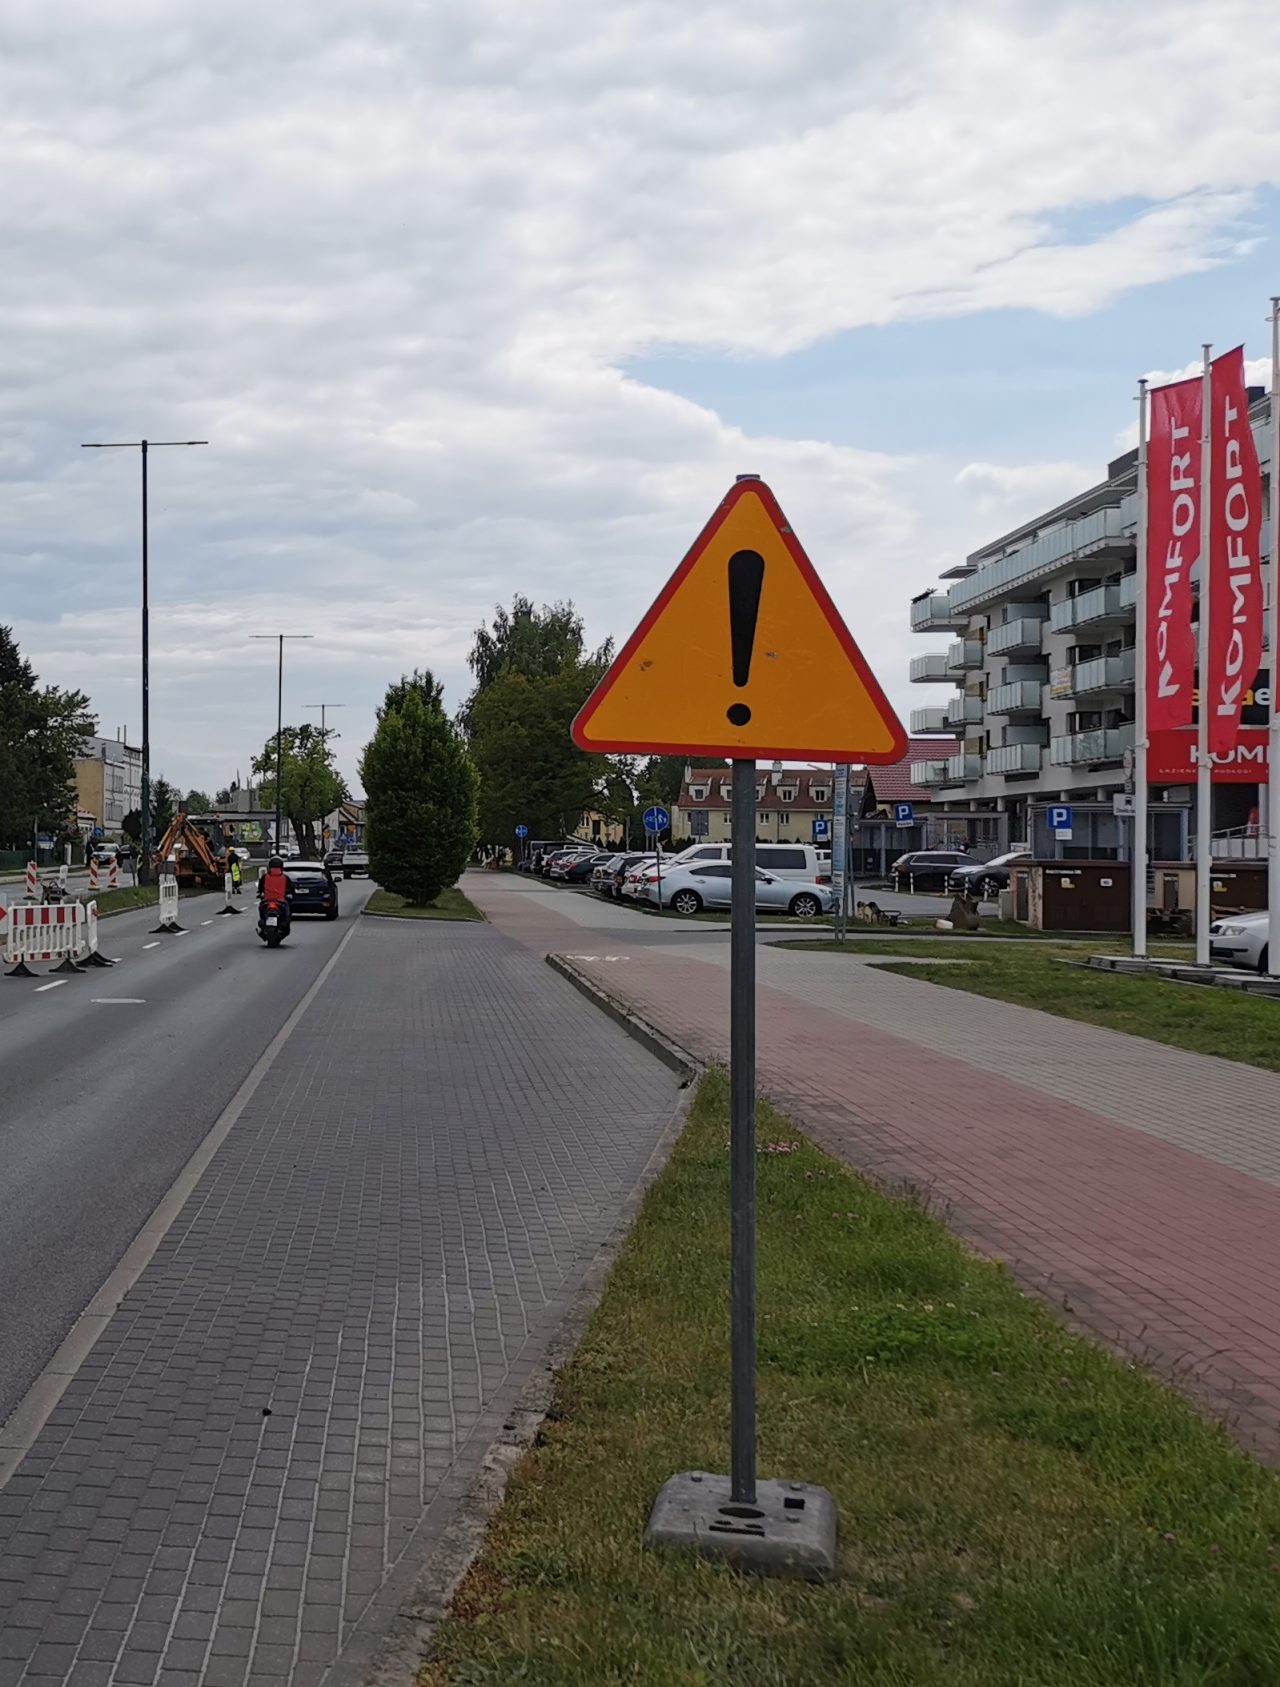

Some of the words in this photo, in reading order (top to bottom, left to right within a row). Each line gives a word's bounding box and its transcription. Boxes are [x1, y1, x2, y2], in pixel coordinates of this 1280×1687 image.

[1157, 417, 1195, 698] KOMFORT
[1217, 396, 1251, 715] KOMFORT
[898, 805, 909, 819] P
[1053, 808, 1067, 826] P
